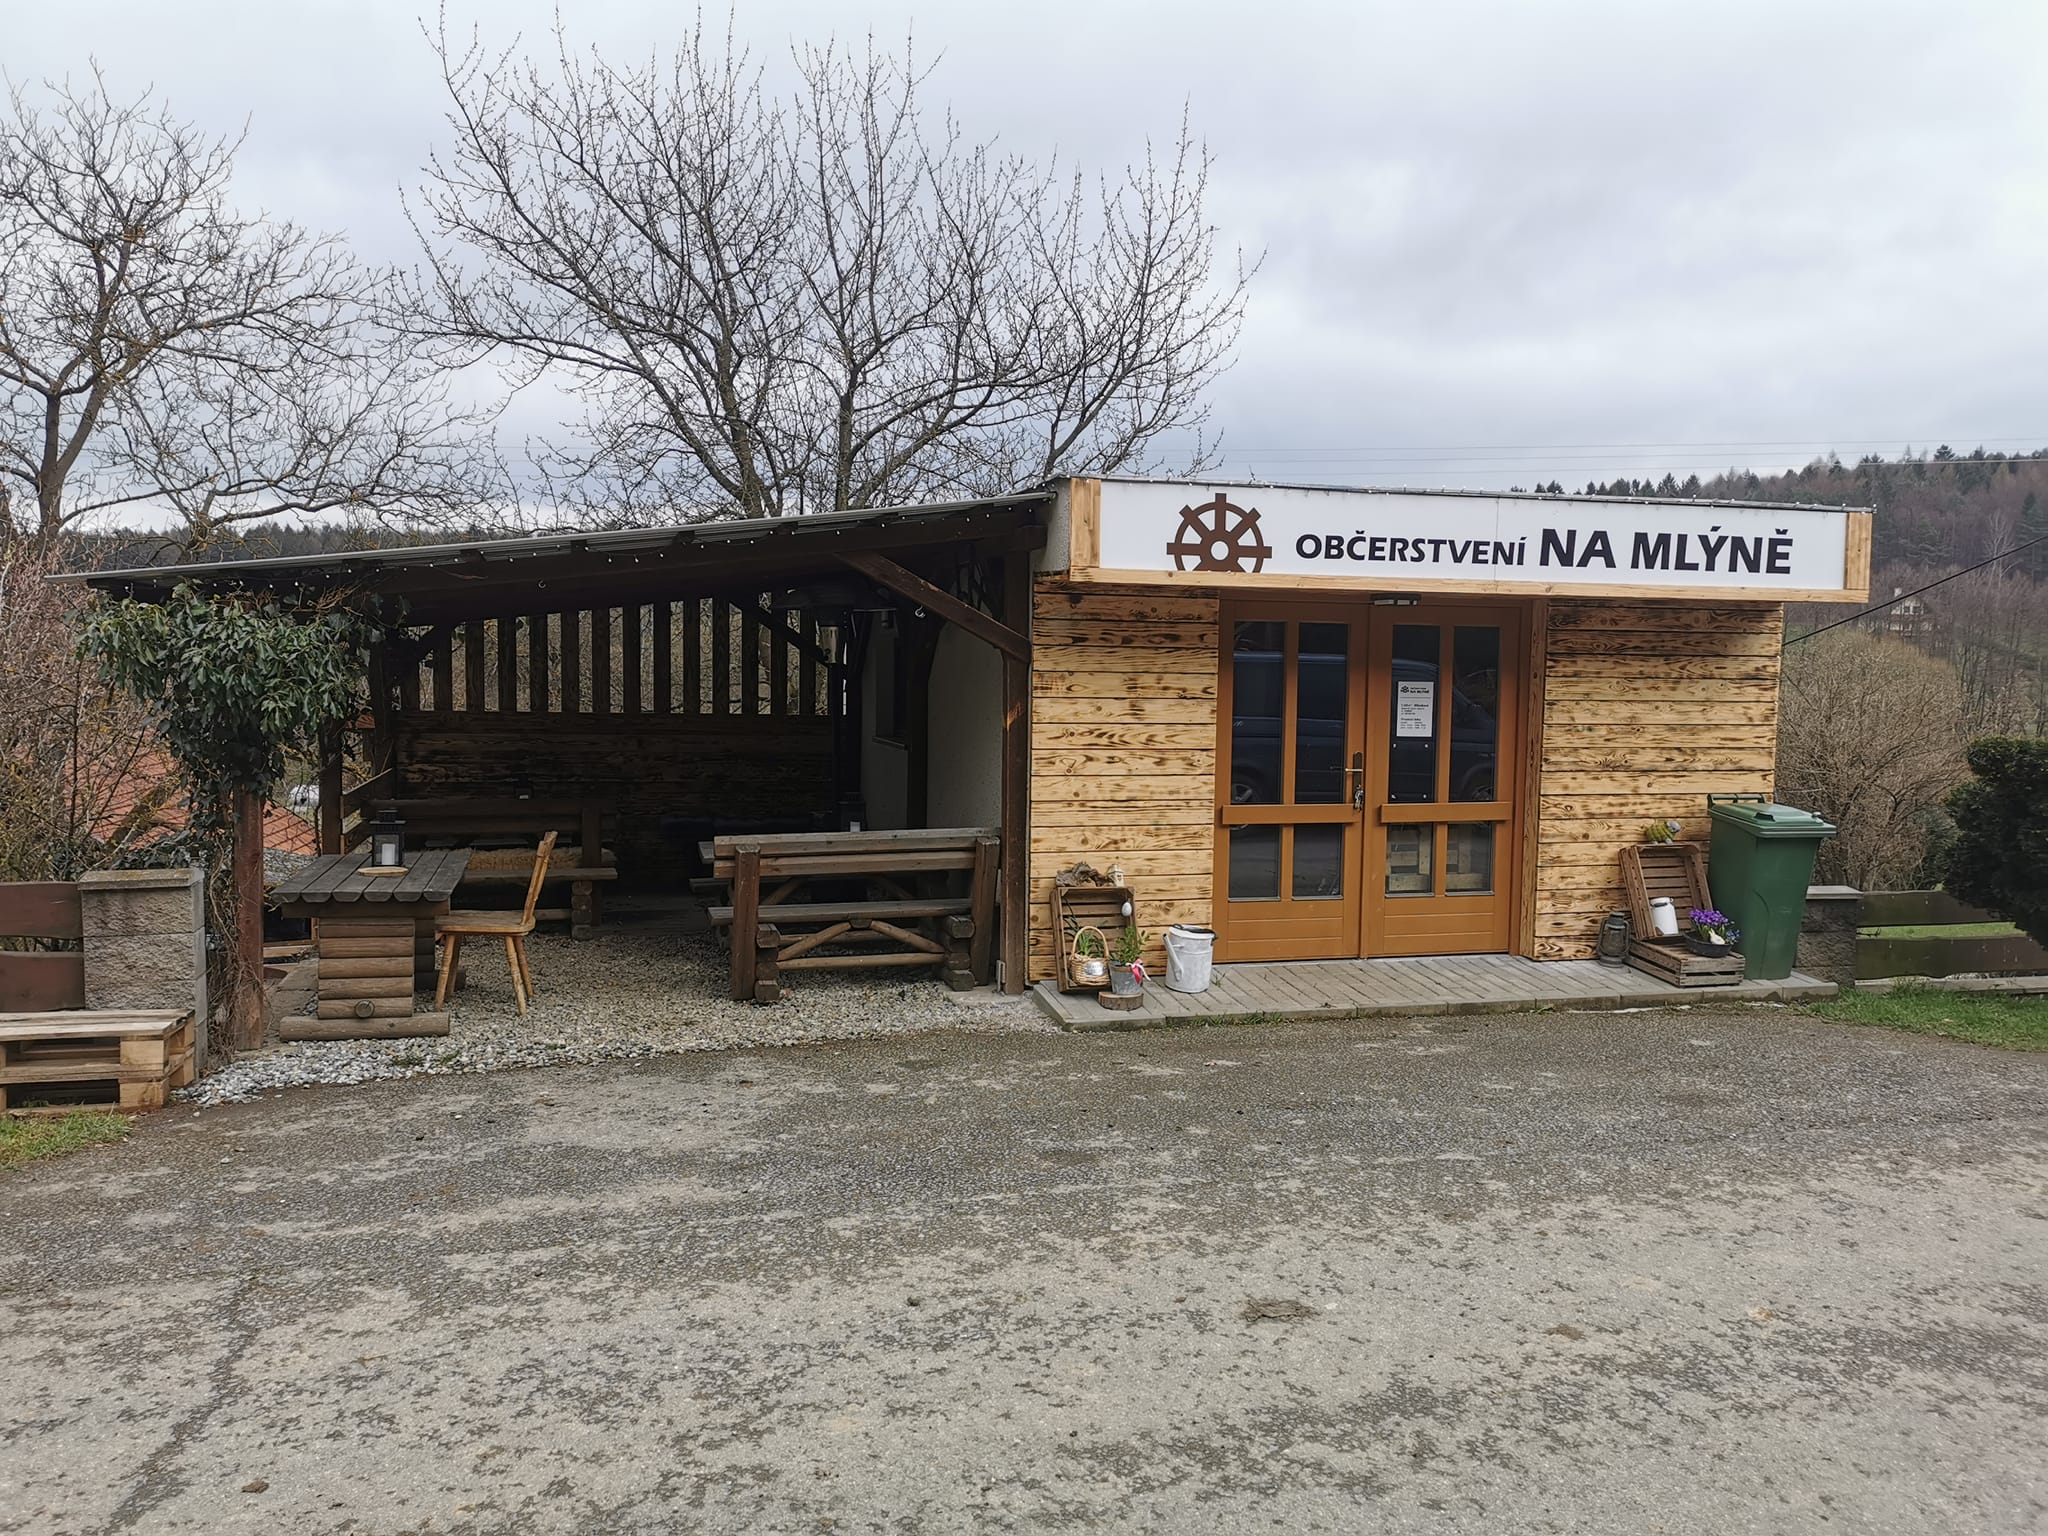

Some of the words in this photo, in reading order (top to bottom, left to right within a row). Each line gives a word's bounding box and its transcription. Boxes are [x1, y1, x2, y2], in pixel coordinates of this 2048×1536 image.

[1295, 530, 1526, 566] OBČERSTVENÍ
[1539, 528, 1617, 569] NA
[1630, 526, 1793, 574] MLÝNĚ
